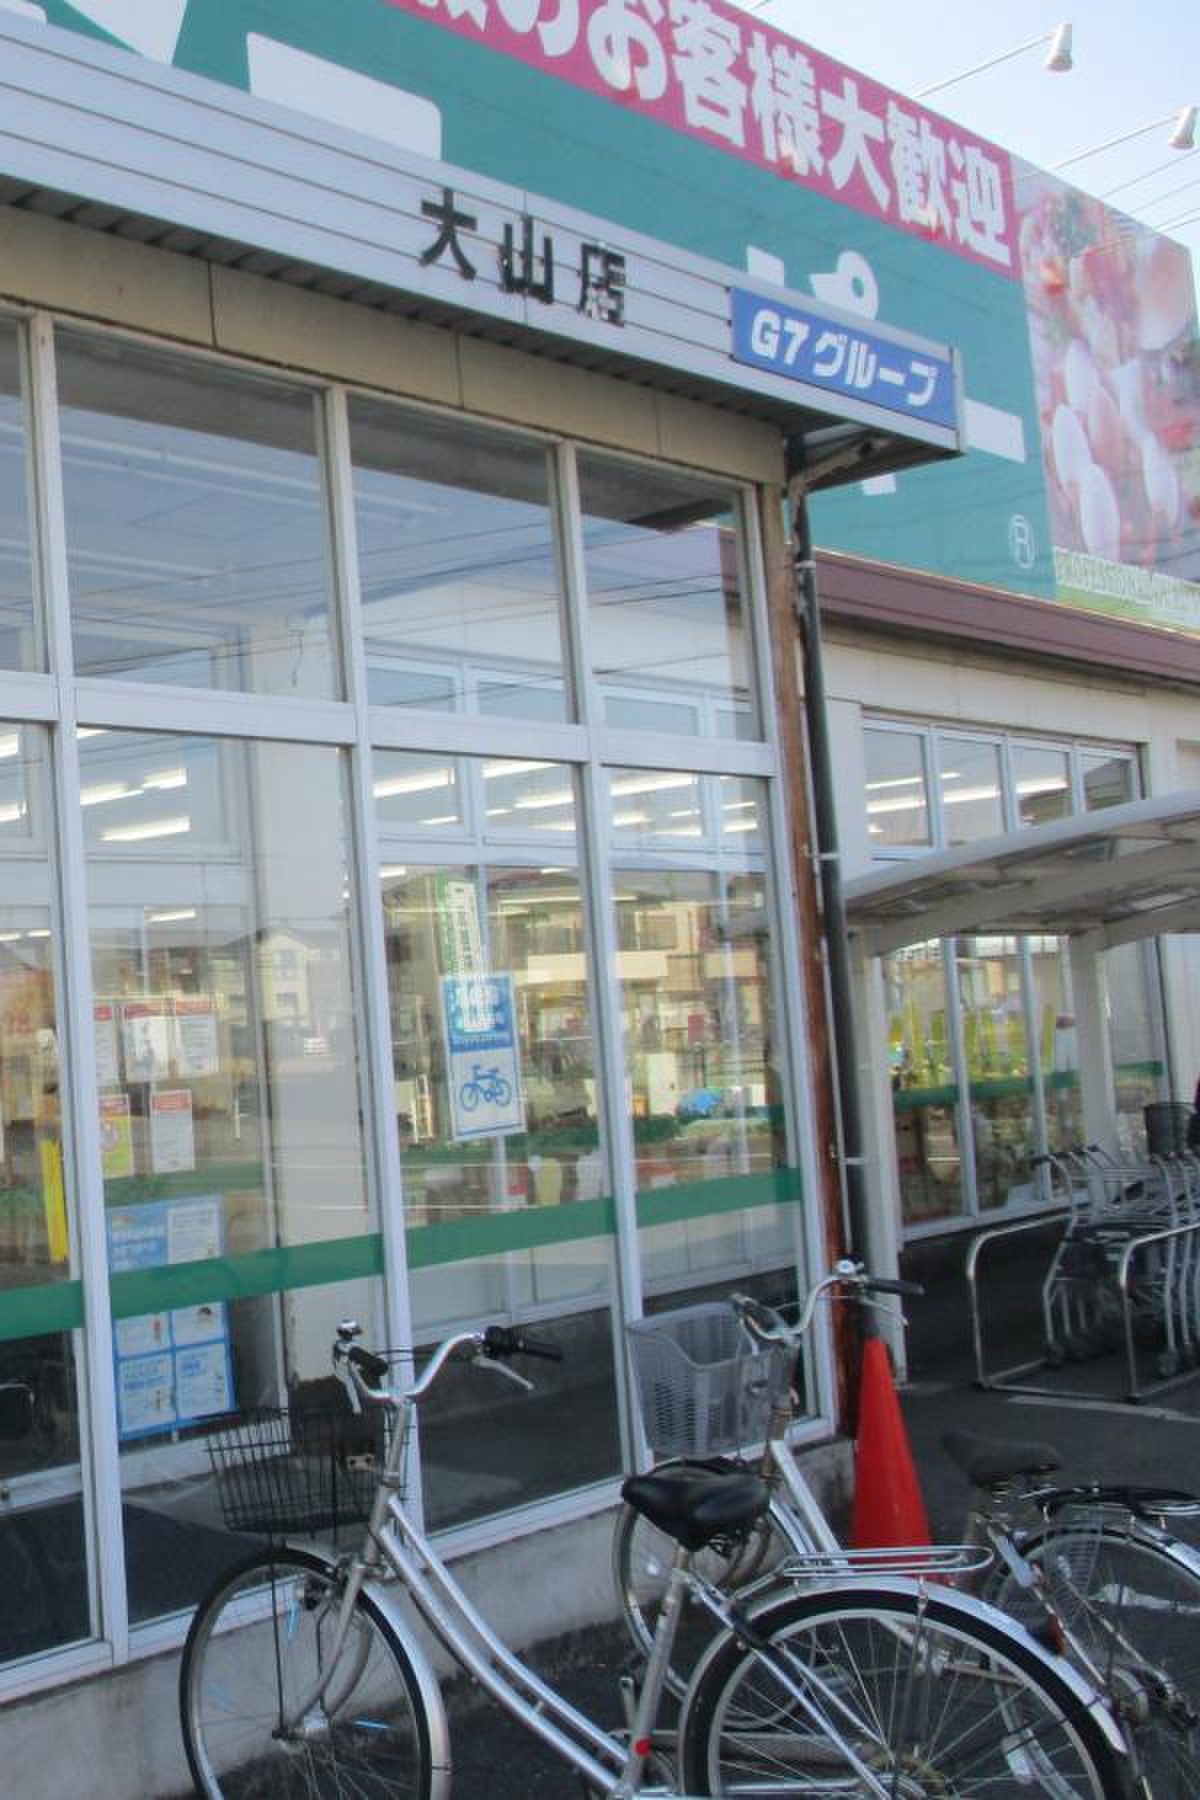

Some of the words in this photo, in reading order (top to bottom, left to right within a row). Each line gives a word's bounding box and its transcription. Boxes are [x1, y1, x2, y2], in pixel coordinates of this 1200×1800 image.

[418, 187, 626, 328] 大山店
[751, 307, 938, 407] G7グループ
